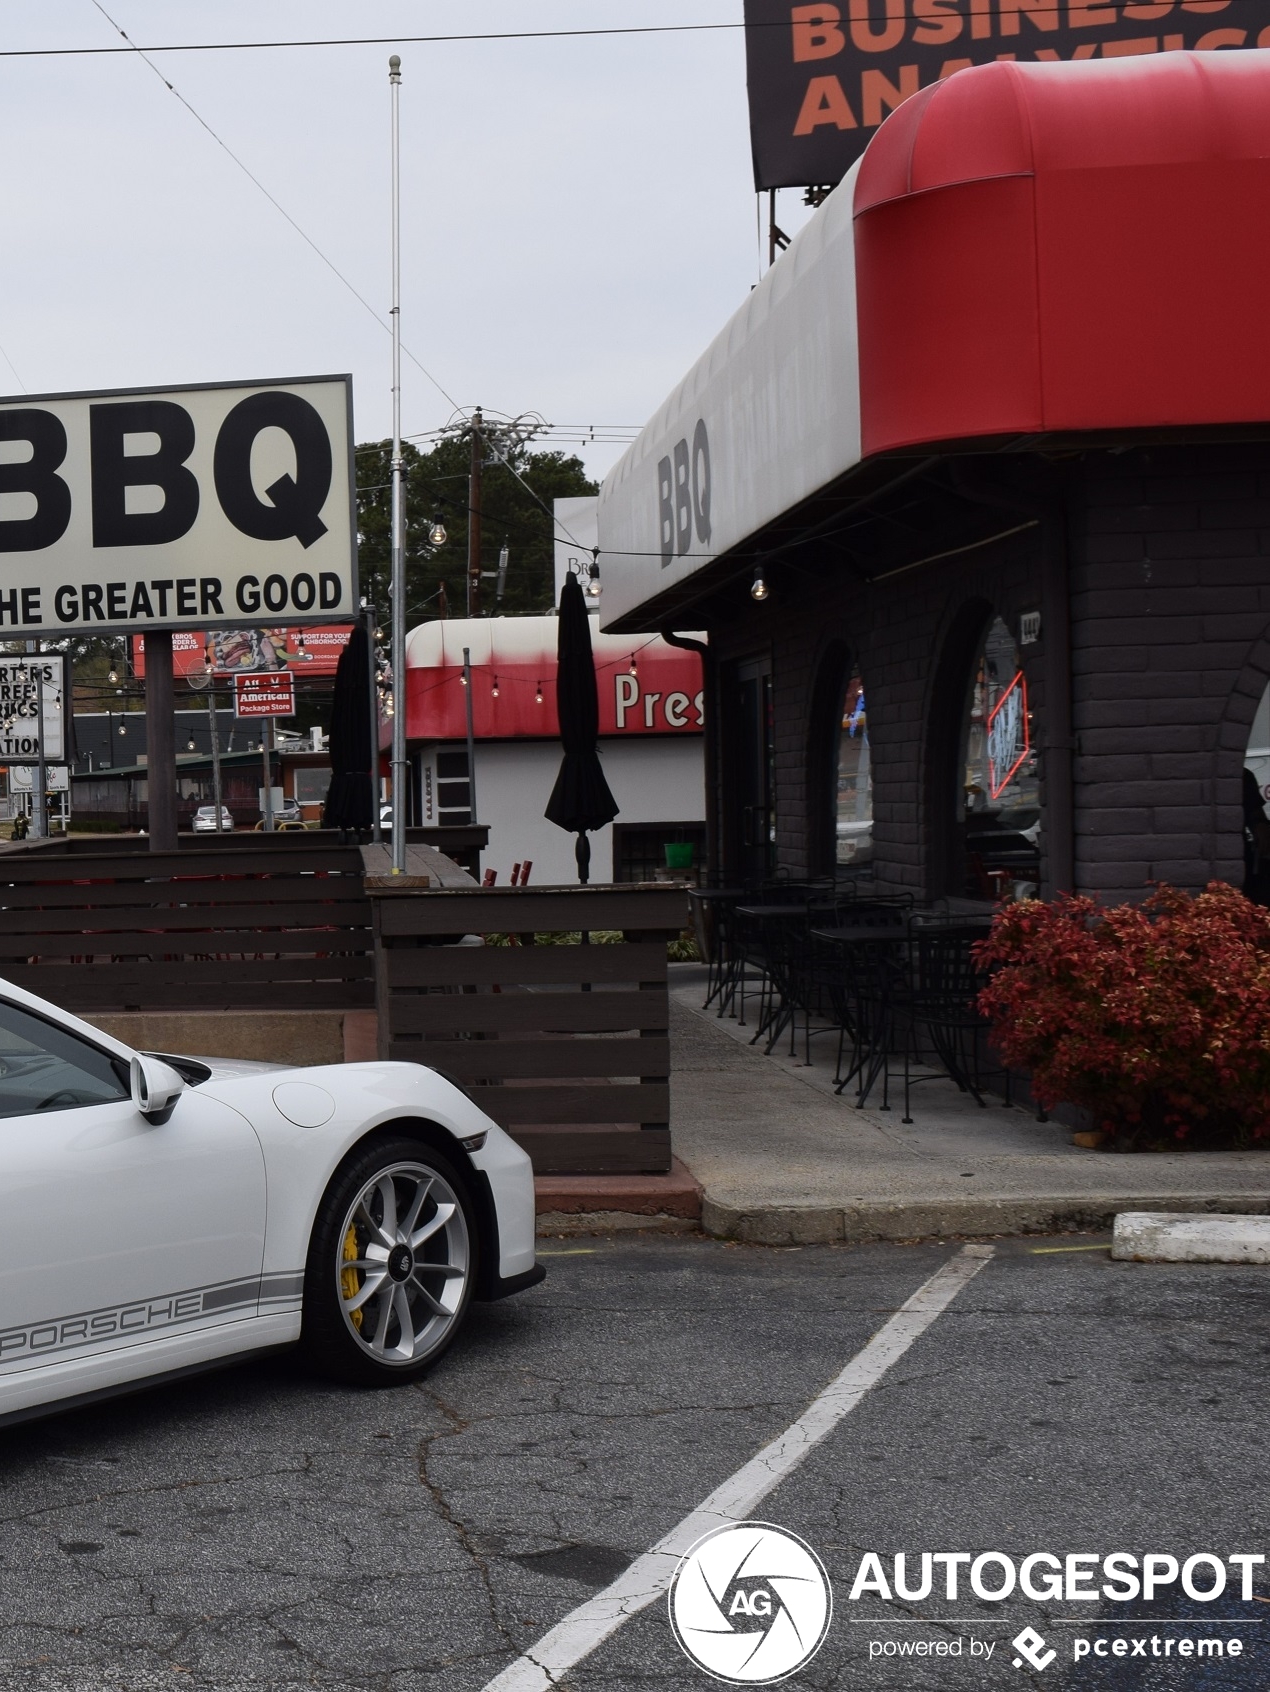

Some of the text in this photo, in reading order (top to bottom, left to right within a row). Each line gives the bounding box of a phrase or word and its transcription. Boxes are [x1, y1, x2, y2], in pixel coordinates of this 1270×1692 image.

[792, 0, 1233, 63] BUSINE
[657, 418, 712, 570] BBQ
[54, 577, 225, 622] GREATER
[236, 572, 342, 614] GOOD
[240, 690, 289, 702] American
[240, 704, 270, 712] Package
